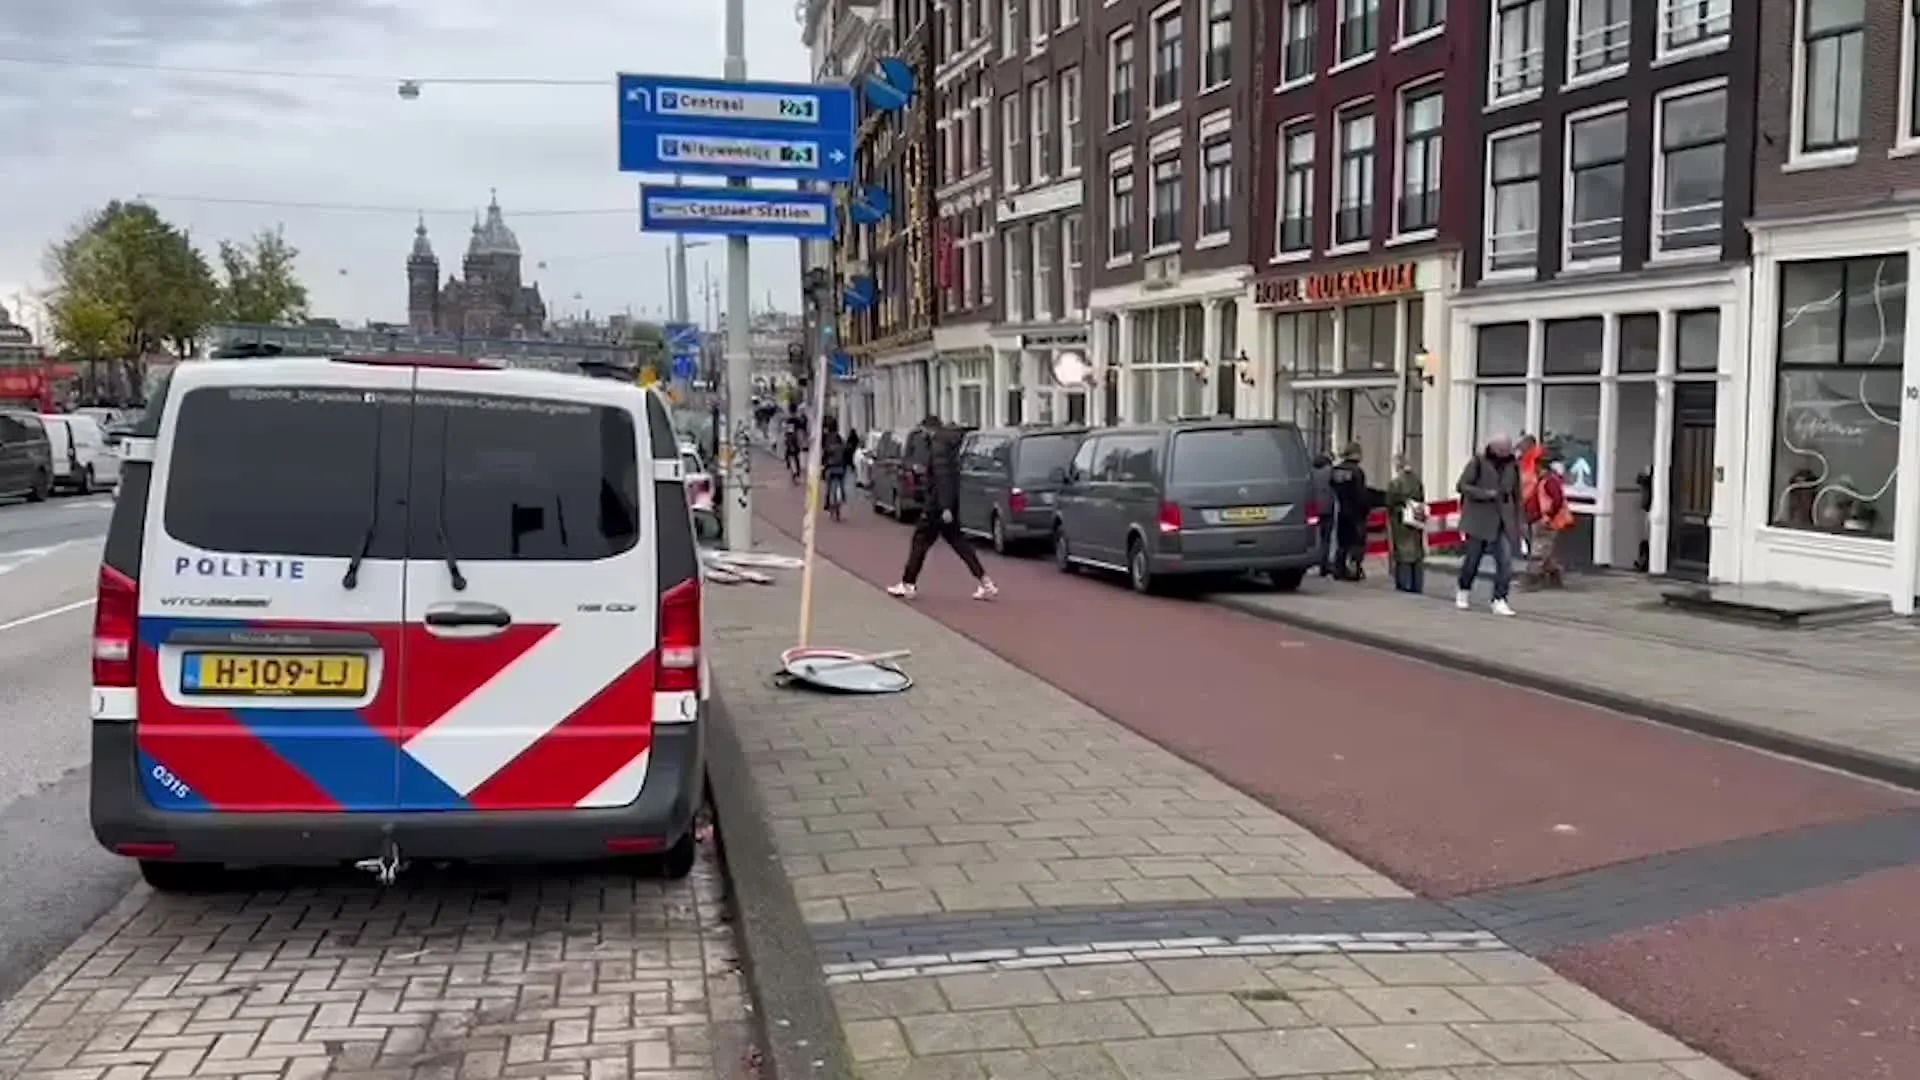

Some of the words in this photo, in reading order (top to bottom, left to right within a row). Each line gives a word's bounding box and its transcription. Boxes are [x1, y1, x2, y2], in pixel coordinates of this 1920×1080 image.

[1256, 277, 1302, 304] HOTEL
[175, 557, 305, 578] POLITIE
[215, 659, 349, 686] H-109-LJ
